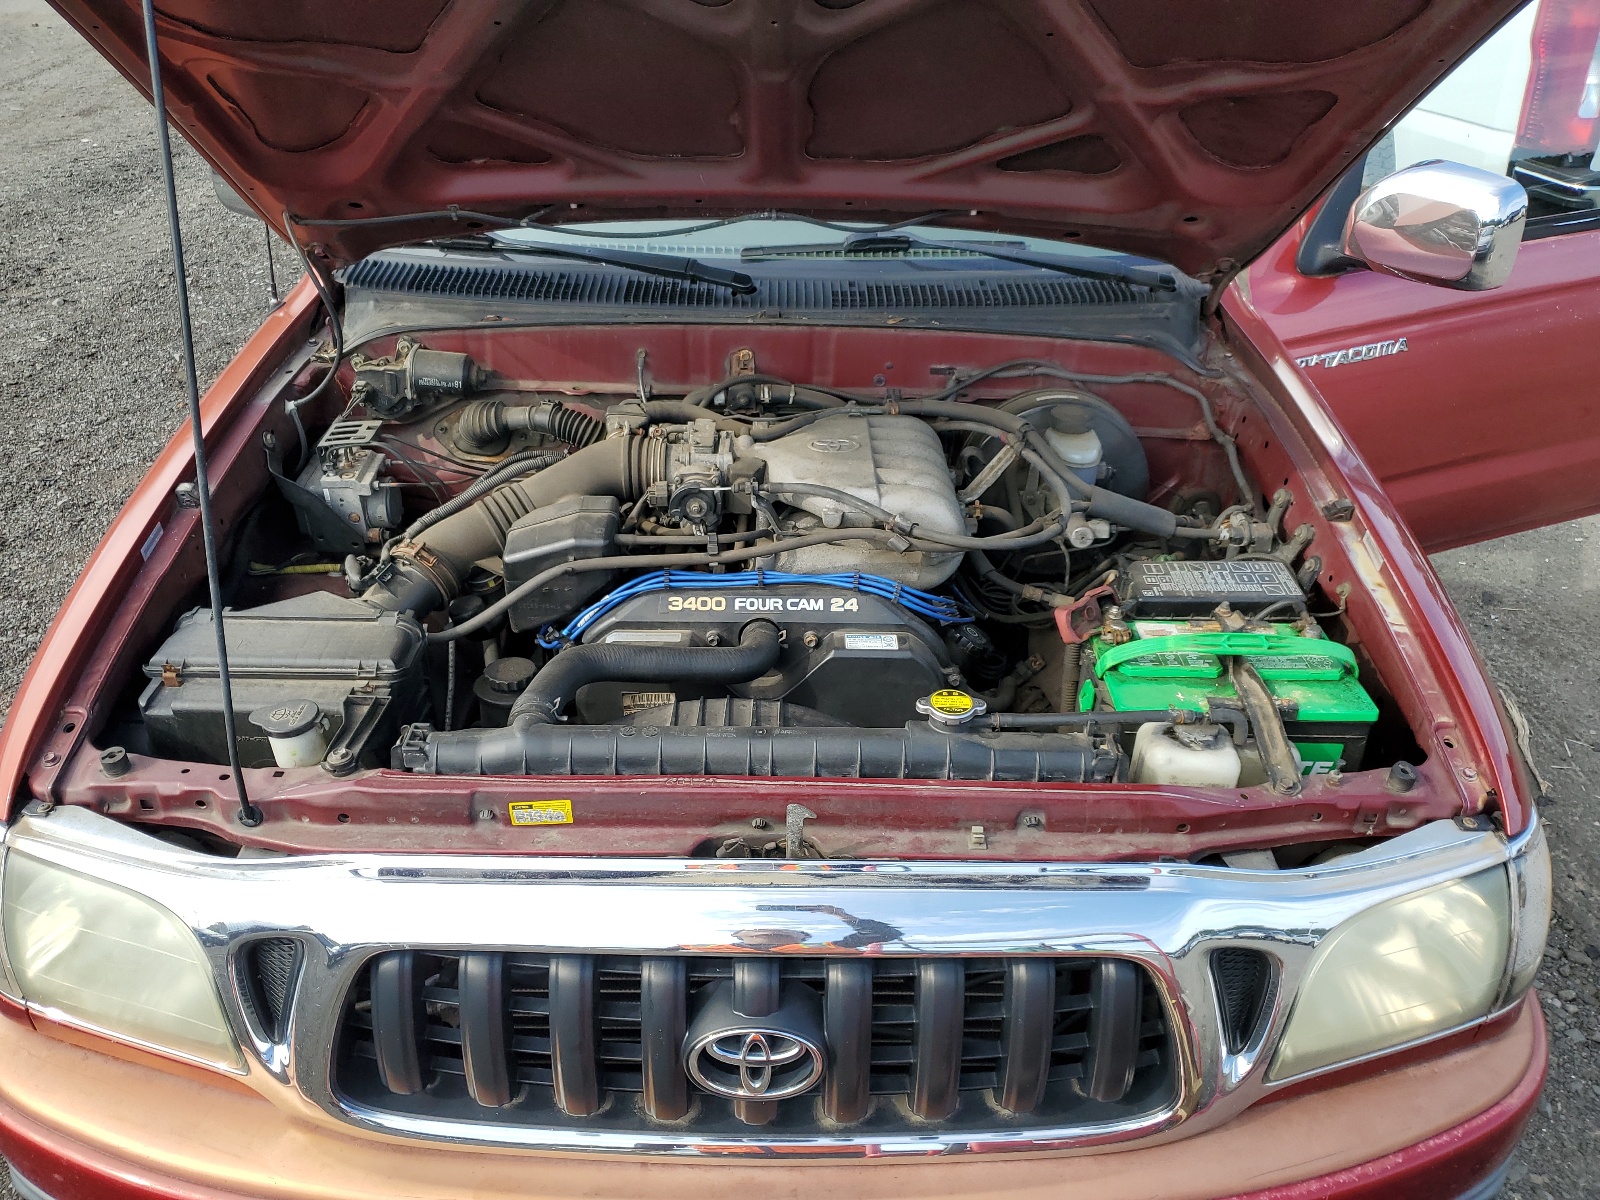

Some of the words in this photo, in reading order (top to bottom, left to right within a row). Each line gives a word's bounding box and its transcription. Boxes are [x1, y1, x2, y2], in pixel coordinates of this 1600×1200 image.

[1322, 337, 1408, 368] TACOMA
[668, 596, 726, 611] 3400
[734, 598, 784, 611] FOUR
[786, 598, 824, 611] CAM
[830, 597, 859, 612] 24
